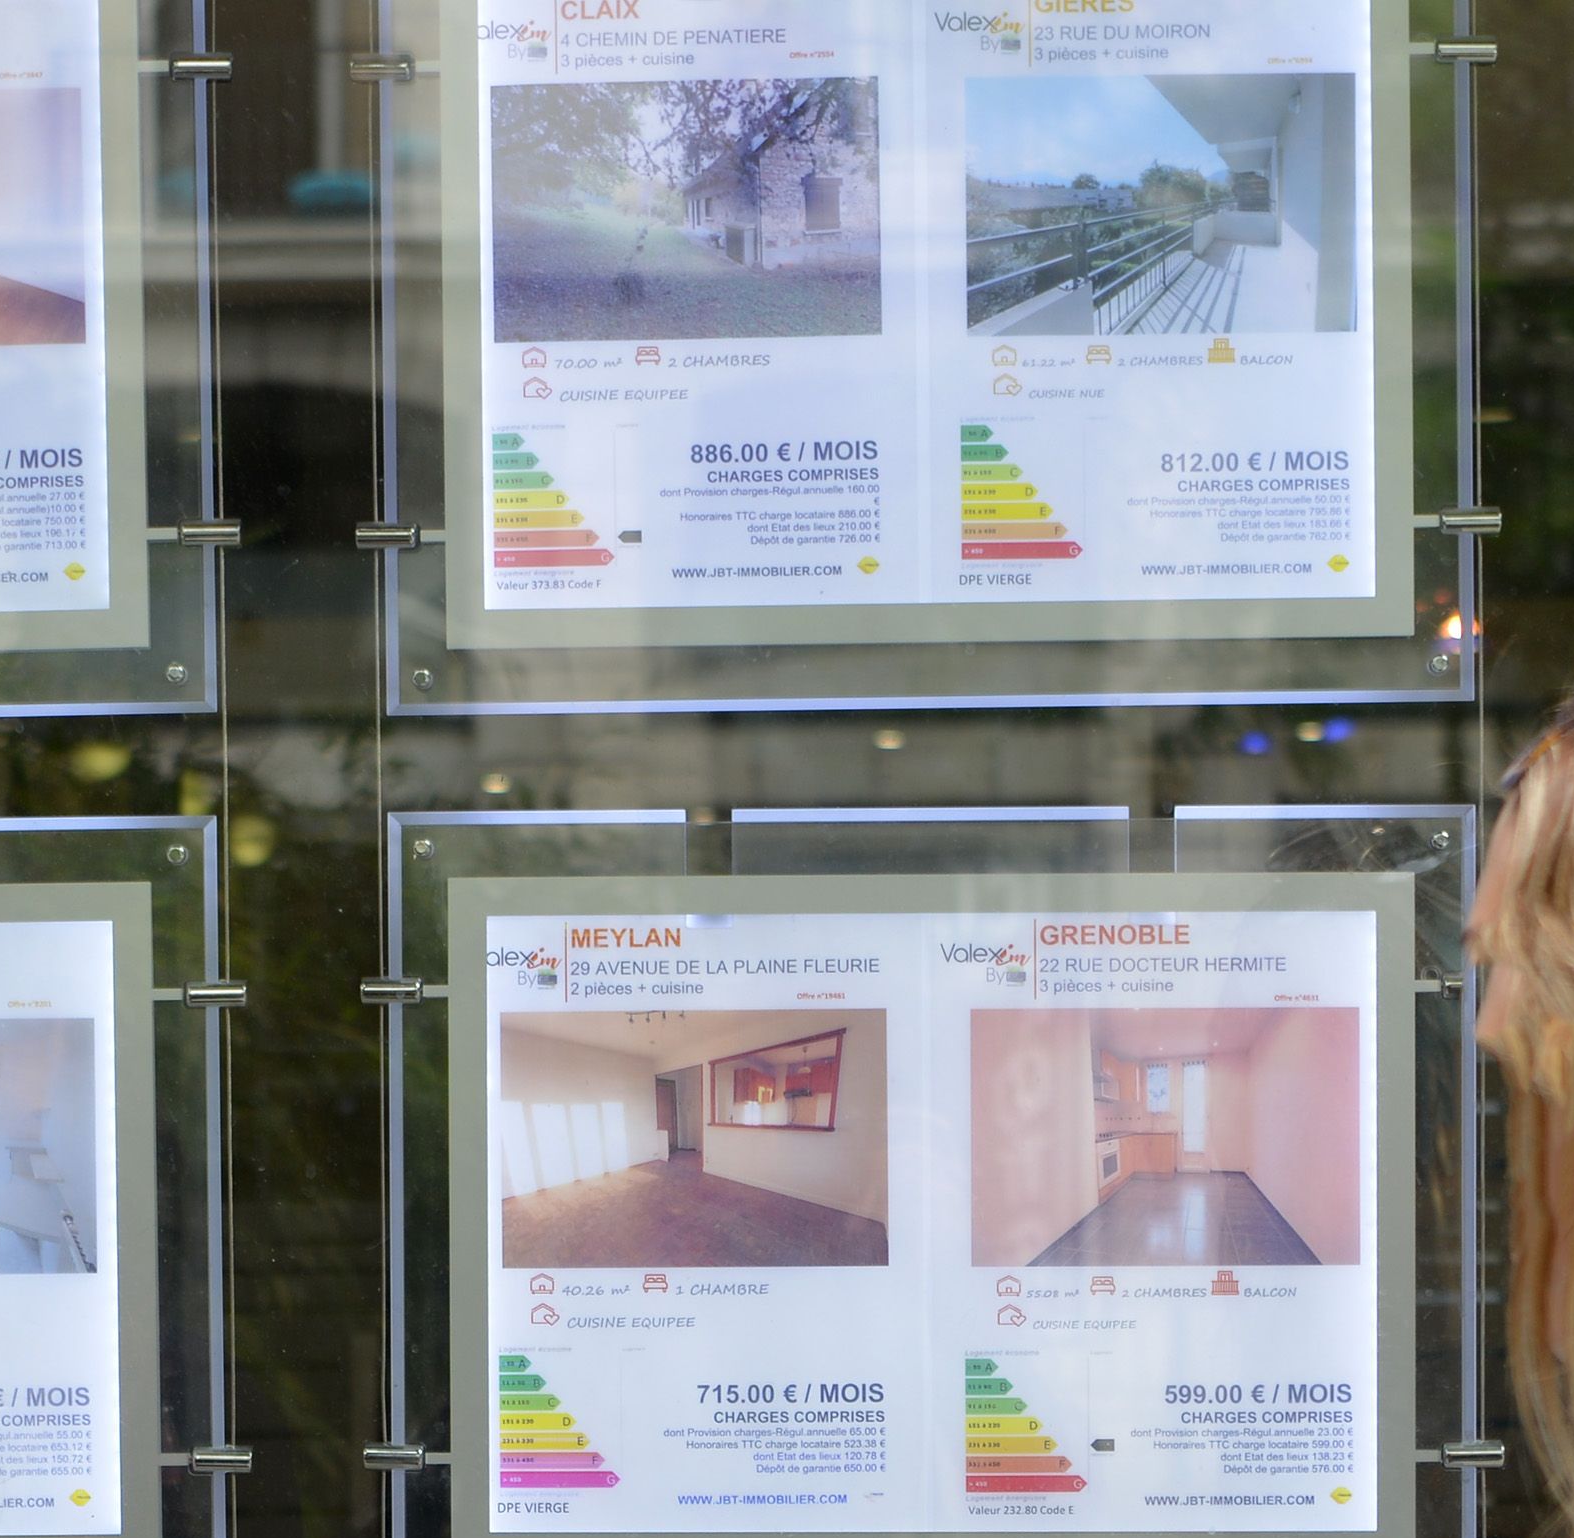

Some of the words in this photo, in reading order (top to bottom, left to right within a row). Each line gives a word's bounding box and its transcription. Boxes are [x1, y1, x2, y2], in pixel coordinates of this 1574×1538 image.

[560, 0, 639, 21] CLAIX
[560, 33, 570, 47] 4
[575, 31, 647, 47] CHEMIN
[653, 30, 678, 46] DE
[683, 27, 787, 45] PENATIERE
[1033, 25, 1055, 41] 23
[1059, 25, 1098, 41] RUE
[1103, 24, 1130, 41] DU
[1135, 23, 1211, 40] MOIRON
[19, 447, 83, 469] MOIS
[690, 443, 768, 464] 886.00
[776, 442, 791, 462] €
[813, 440, 878, 461] MOIS
[1160, 452, 1239, 473] 812.00
[1247, 451, 1262, 472] €
[1284, 450, 1349, 471] MOIS
[671, 565, 842, 579] WWW.JBT-IMMOBILIER.COM
[958, 573, 983, 586] DPE
[986, 572, 1032, 586] VIERGE
[570, 927, 681, 949] MEYLAN
[1039, 924, 1190, 946] GRENOBLE
[570, 960, 591, 976] 29
[594, 960, 670, 976] AVENUE
[676, 959, 700, 975] DE
[706, 959, 729, 975] LA
[733, 958, 798, 974] PLAINE
[803, 957, 880, 974] FLEURIE
[1039, 957, 1059, 973] 22
[1065, 957, 1103, 973] RUE
[1109, 956, 1199, 973] DOCTEUR
[1204, 956, 1287, 972] HERMITE
[26, 1386, 90, 1407] MOIS
[696, 1384, 775, 1404] 715.00
[783, 1383, 797, 1404] €
[820, 1382, 884, 1403] MOIS
[1164, 1384, 1242, 1404] 599.00
[1250, 1384, 1265, 1404] €
[1288, 1383, 1352, 1404] MOIS
[0, 1413, 91, 1427] COMPRISES
[713, 1410, 790, 1424] CHARGES
[793, 1410, 885, 1423] COMPRISES
[1180, 1411, 1257, 1424] CHARGES
[1261, 1410, 1353, 1427] COMPRISES
[685, 1439, 739, 1450] Honoraires
[740, 1439, 763, 1450] TTC
[764, 1439, 798, 1451] charge
[800, 1438, 842, 1449] locataire
[786, 1463, 800, 1473] de
[802, 1464, 842, 1475] garantie
[497, 1501, 521, 1514] DPE
[524, 1501, 570, 1514] VIERGE
[677, 1493, 848, 1505] WWW.JBT-IMMOBILIER.COM
[967, 1505, 1001, 1515] Valeur
[1039, 1505, 1066, 1515] Code
